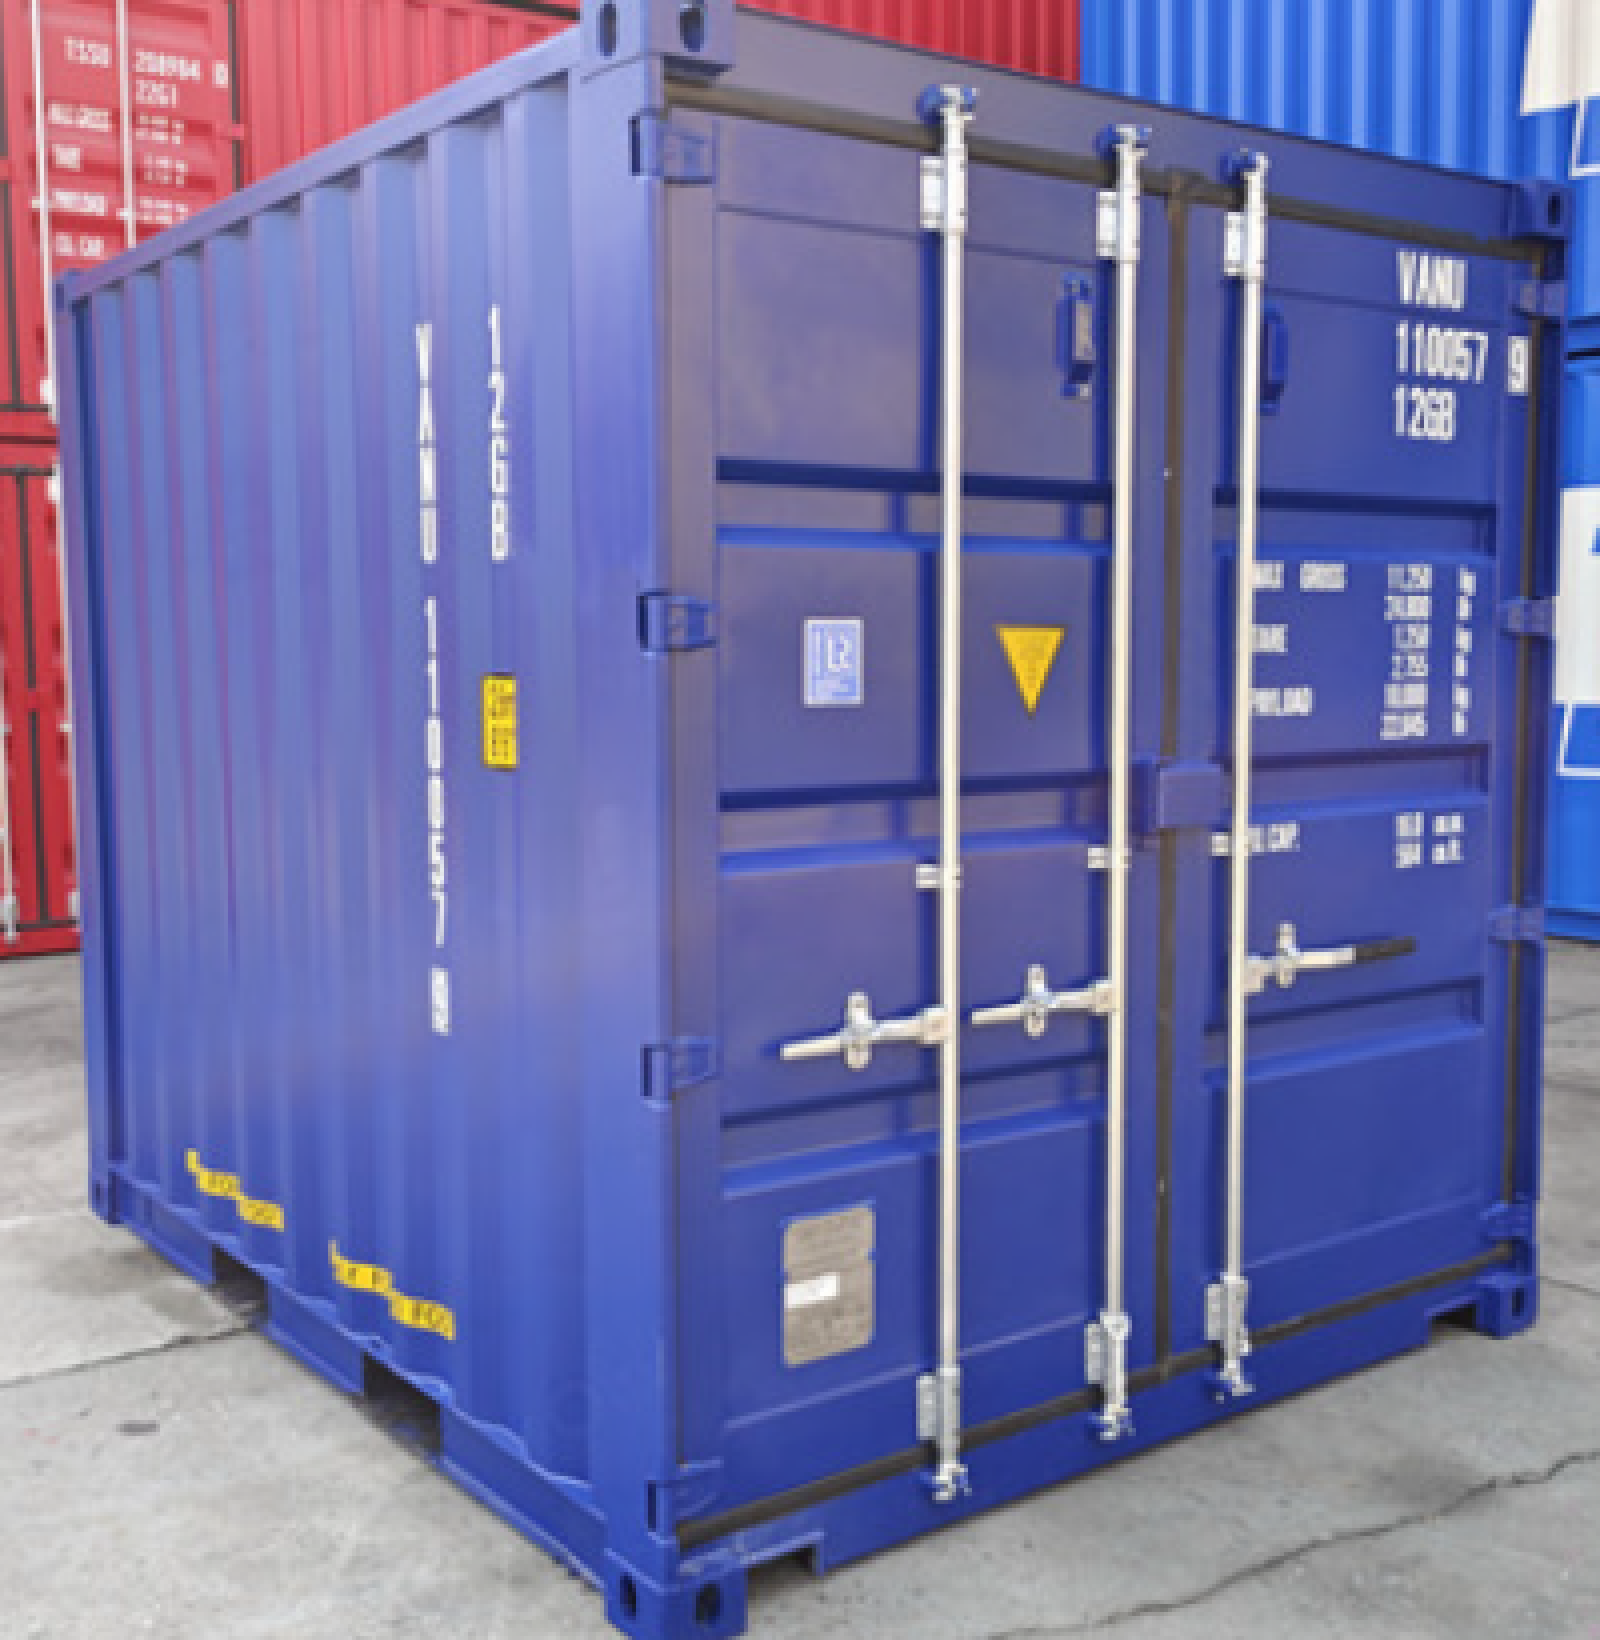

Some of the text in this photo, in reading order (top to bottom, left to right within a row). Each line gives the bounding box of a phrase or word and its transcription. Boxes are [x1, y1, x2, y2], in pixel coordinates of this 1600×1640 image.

[1396, 249, 1467, 312] VANU
[1396, 320, 1529, 394] 110057 9
